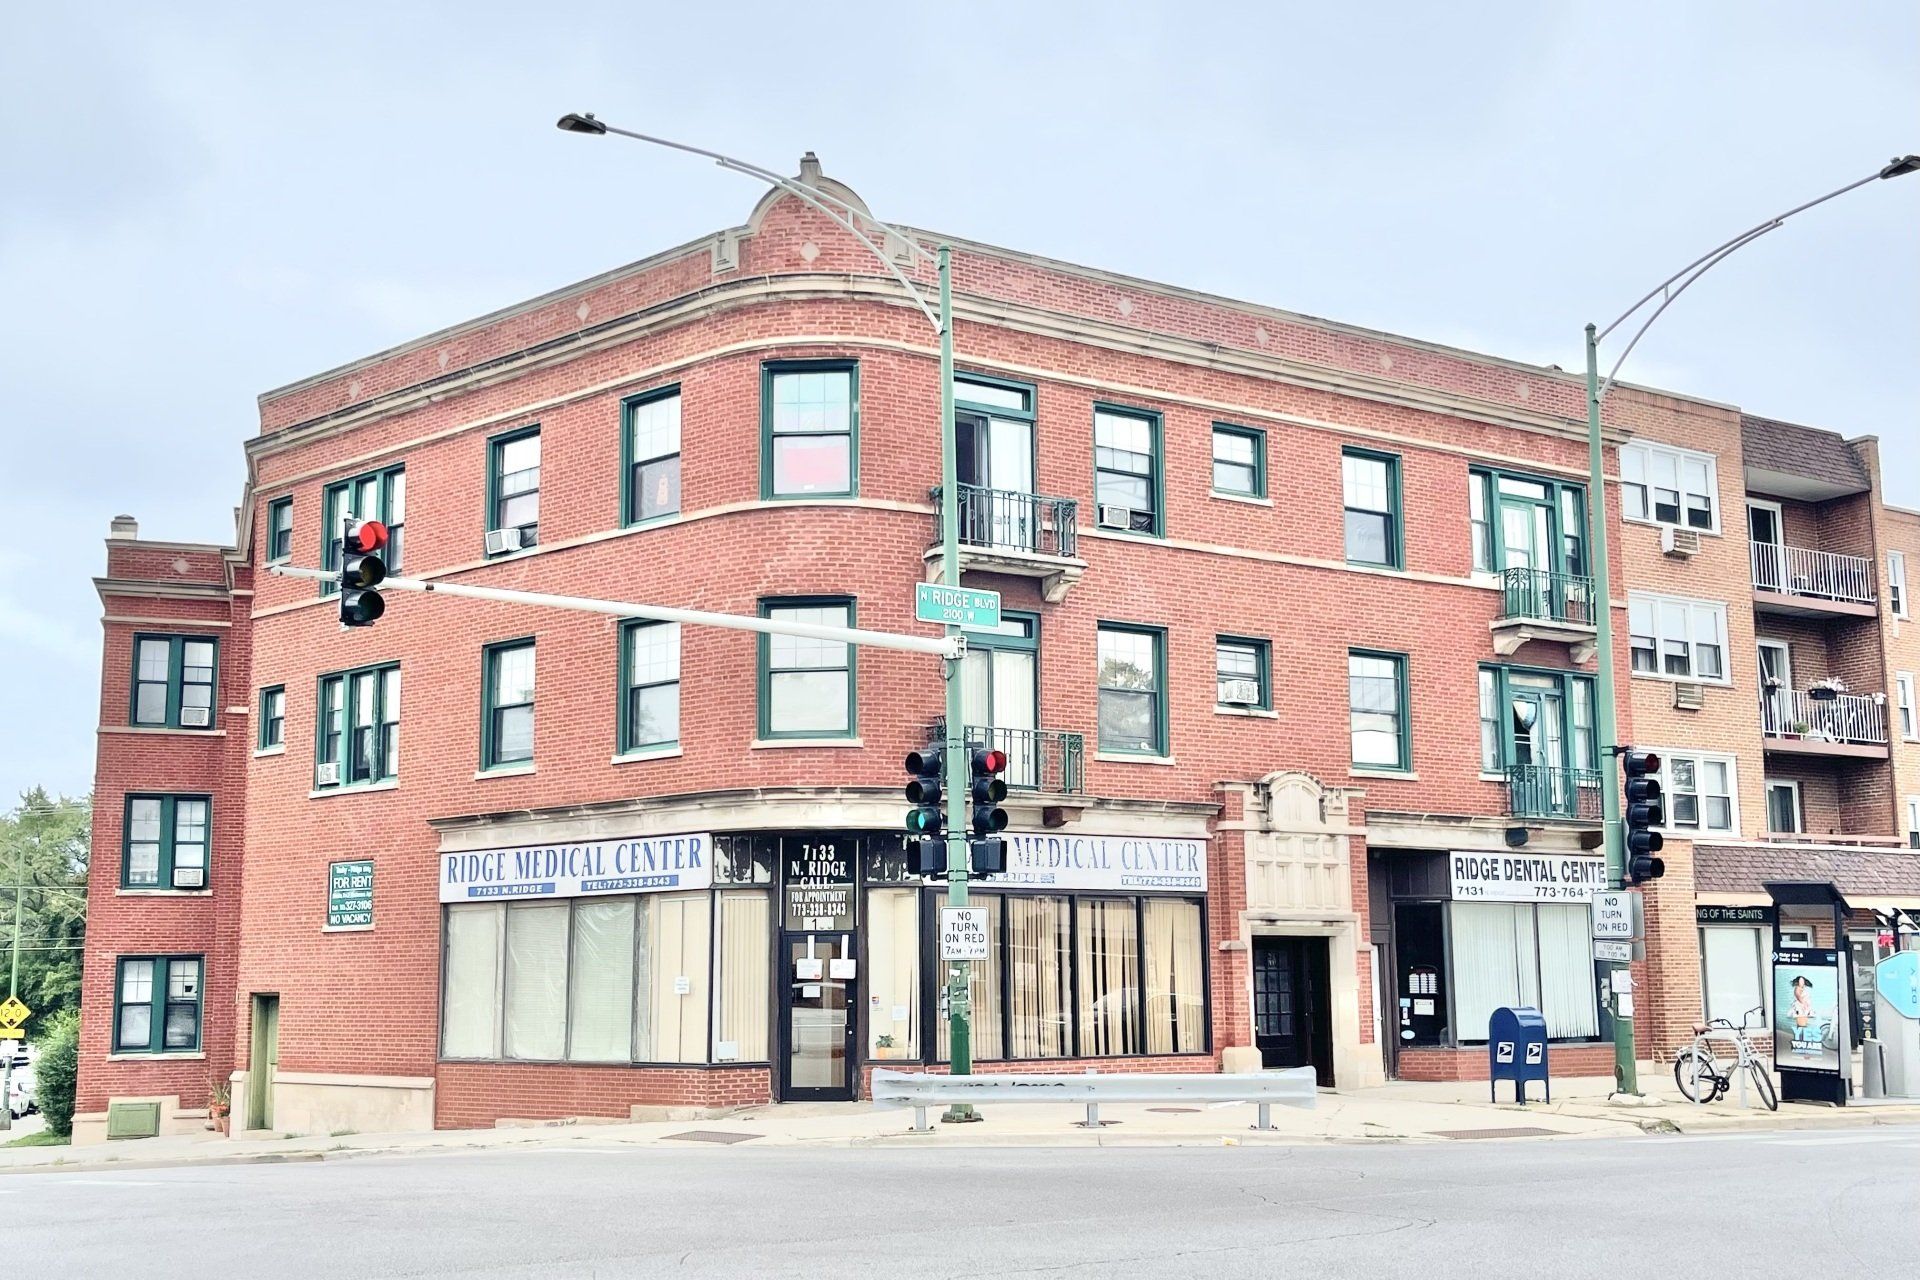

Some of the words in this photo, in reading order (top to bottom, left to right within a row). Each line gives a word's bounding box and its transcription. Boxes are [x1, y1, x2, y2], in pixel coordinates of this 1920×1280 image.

[921, 591, 927, 600] N
[932, 590, 970, 608] RIDGE
[974, 597, 996, 609] BLVD
[943, 608, 963, 619] 2100
[967, 610, 975, 621] W
[803, 844, 835, 861] 7133
[1013, 836, 1111, 870] MEDICAL
[1121, 840, 1199, 872] CENTER
[447, 852, 506, 884] RIDGE
[514, 846, 606, 880] MEDICAL
[615, 838, 702, 874] CENTER
[791, 860, 804, 876] N.
[808, 860, 847, 877] RIDGE
[1454, 857, 1500, 881] RIDGE
[1503, 858, 1557, 882] DENTAL
[1561, 860, 1606, 884] CENTE
[333, 876, 350, 889] FOR
[351, 875, 373, 887] RENT
[800, 876, 834, 890] CALL:
[477, 887, 499, 896] 7133
[501, 884, 543, 894] N.RIDGE
[791, 891, 804, 903] FOR
[804, 890, 847, 903] APPOINTMENT
[1457, 885, 1484, 896] 7131
[1605, 897, 1618, 906] NO
[331, 914, 341, 924] NO
[342, 913, 372, 923] VACANCY
[957, 911, 972, 921] NO
[1601, 910, 1622, 919] TURN
[1709, 909, 1720, 919] OF
[1721, 909, 1737, 919] THE
[1737, 909, 1763, 920] SAINTS
[951, 922, 978, 932] TURN
[1597, 922, 1608, 932] ON
[1611, 922, 1628, 932] RED
[945, 933, 959, 943] ON
[965, 933, 984, 943] RED
[1791, 1026, 1823, 1042] YES
